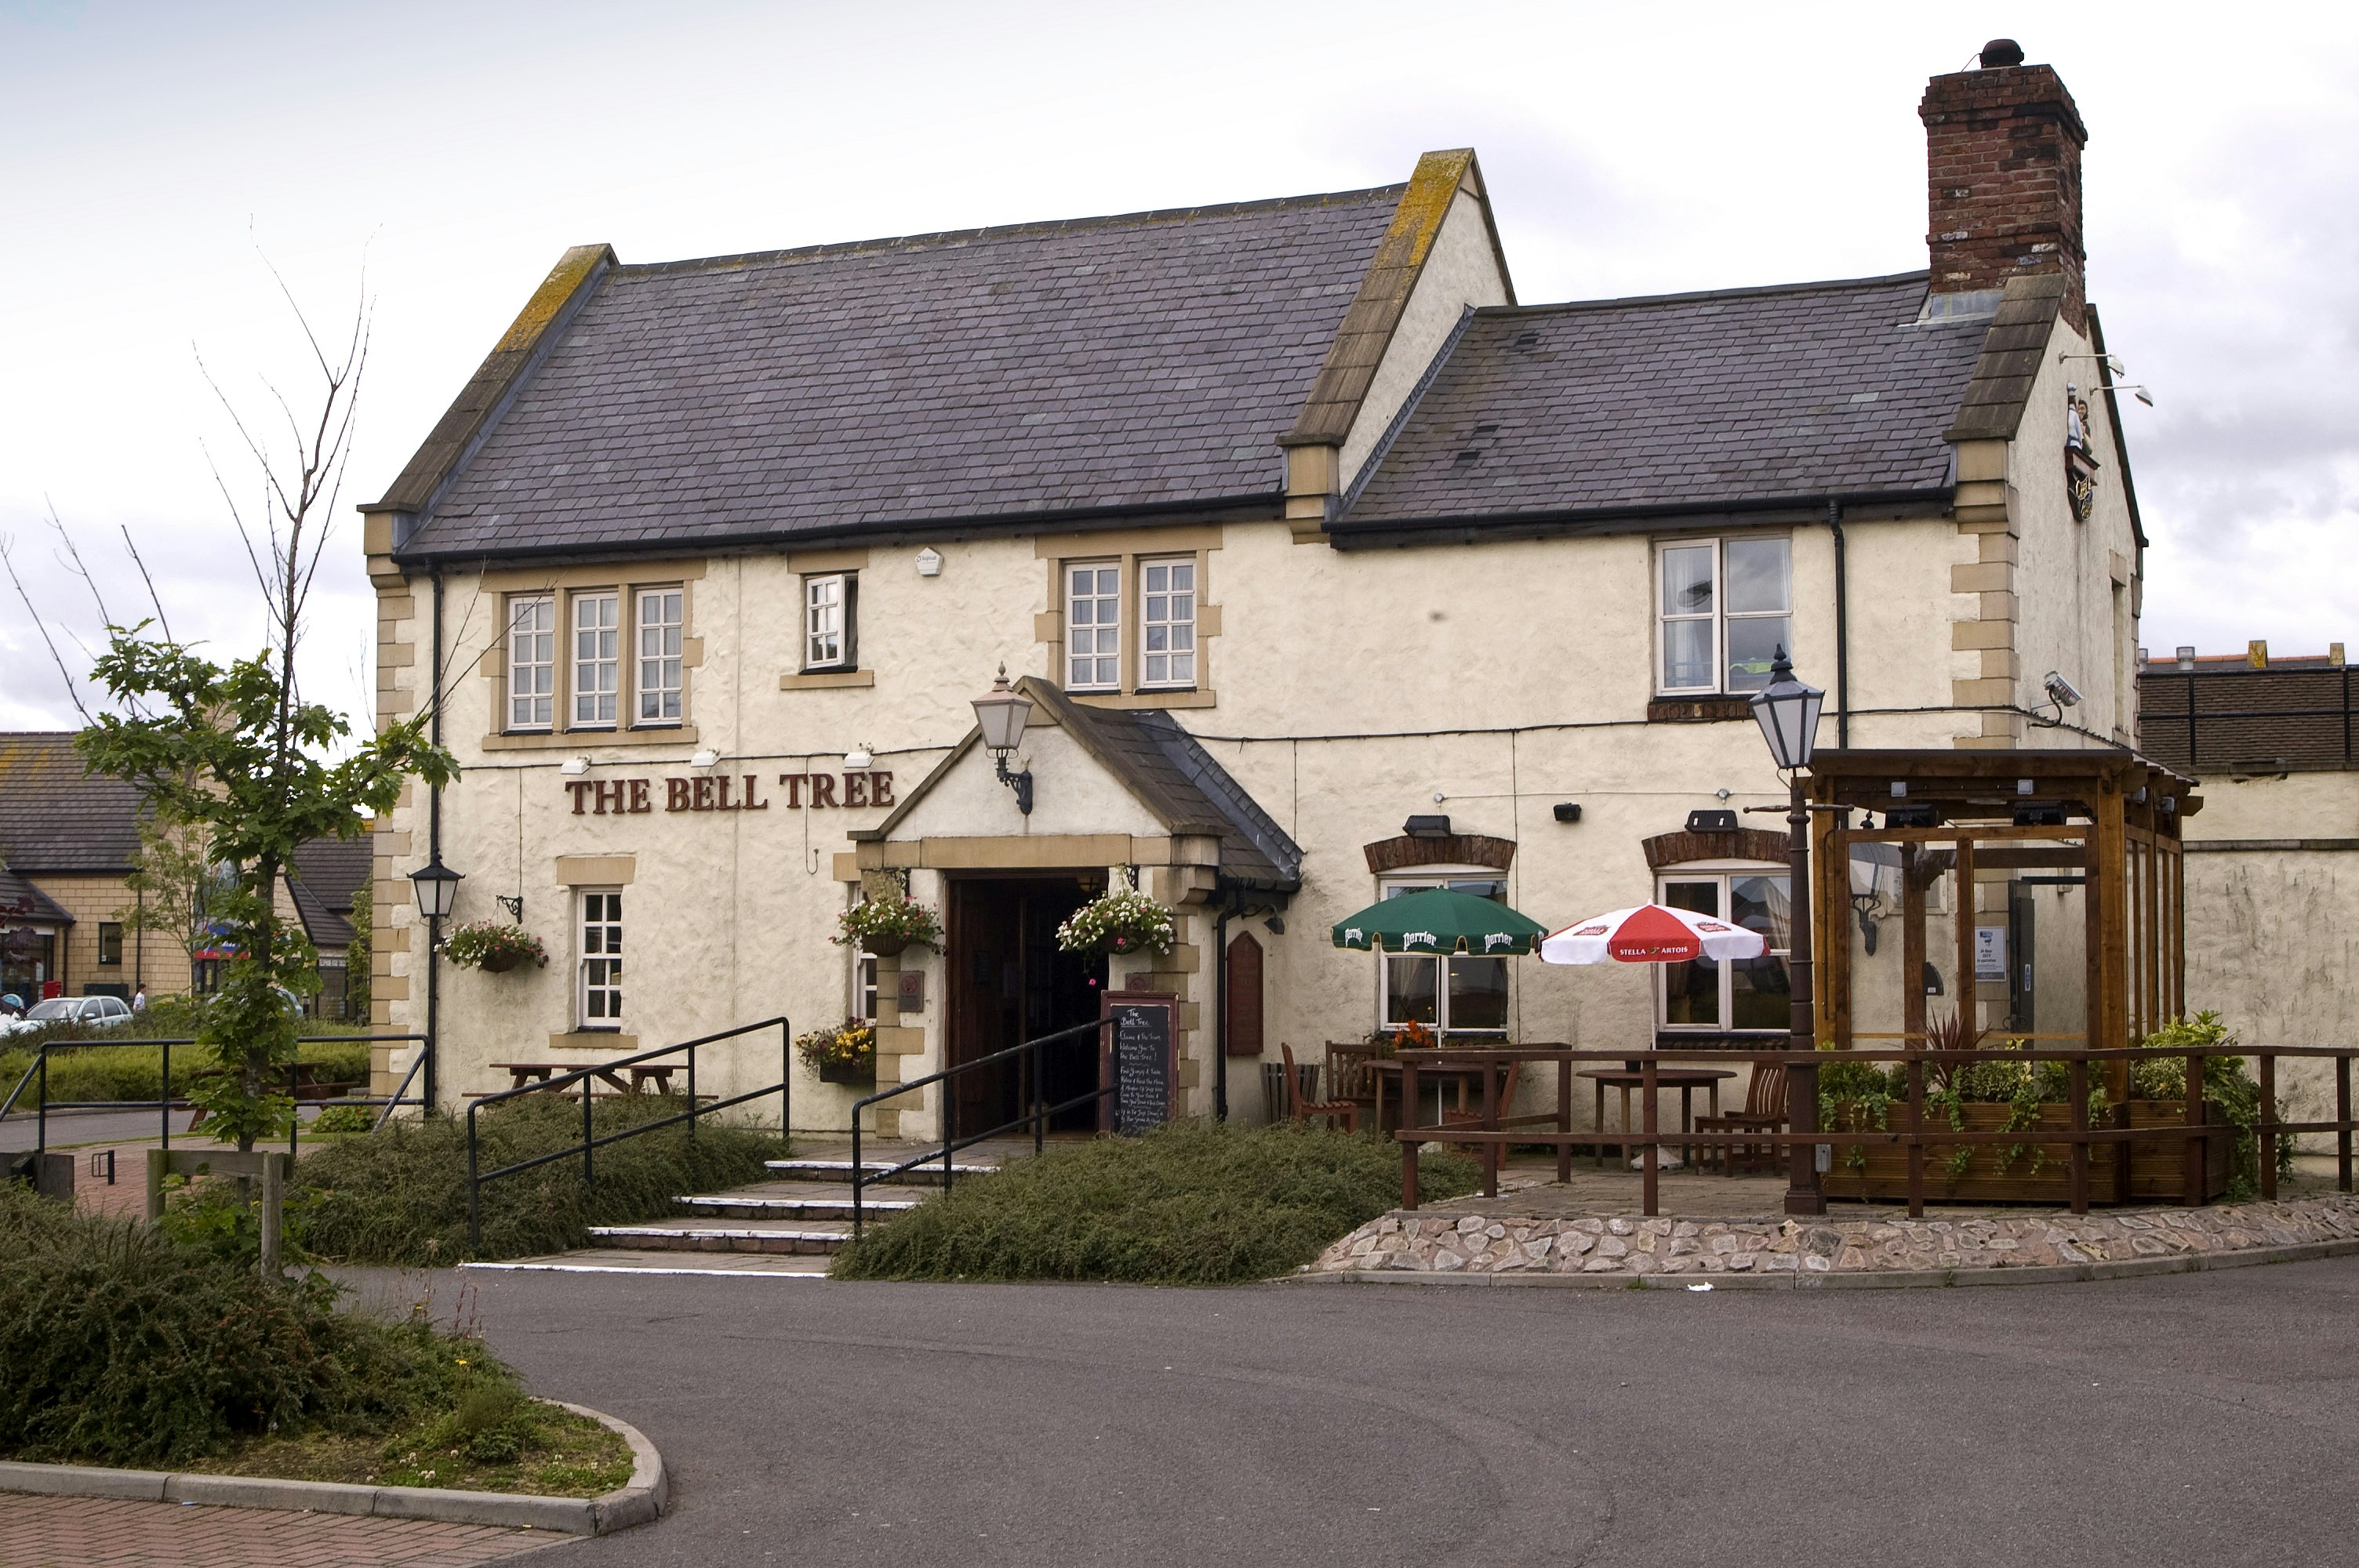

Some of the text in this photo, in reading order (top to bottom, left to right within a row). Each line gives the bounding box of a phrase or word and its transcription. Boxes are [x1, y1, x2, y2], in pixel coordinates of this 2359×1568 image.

[565, 771, 895, 815] THE BELL TREE
[1661, 946, 1688, 954] ARTOIS
[1127, 1007, 1140, 1018] The
[1121, 1017, 1150, 1026] Bell Tree
